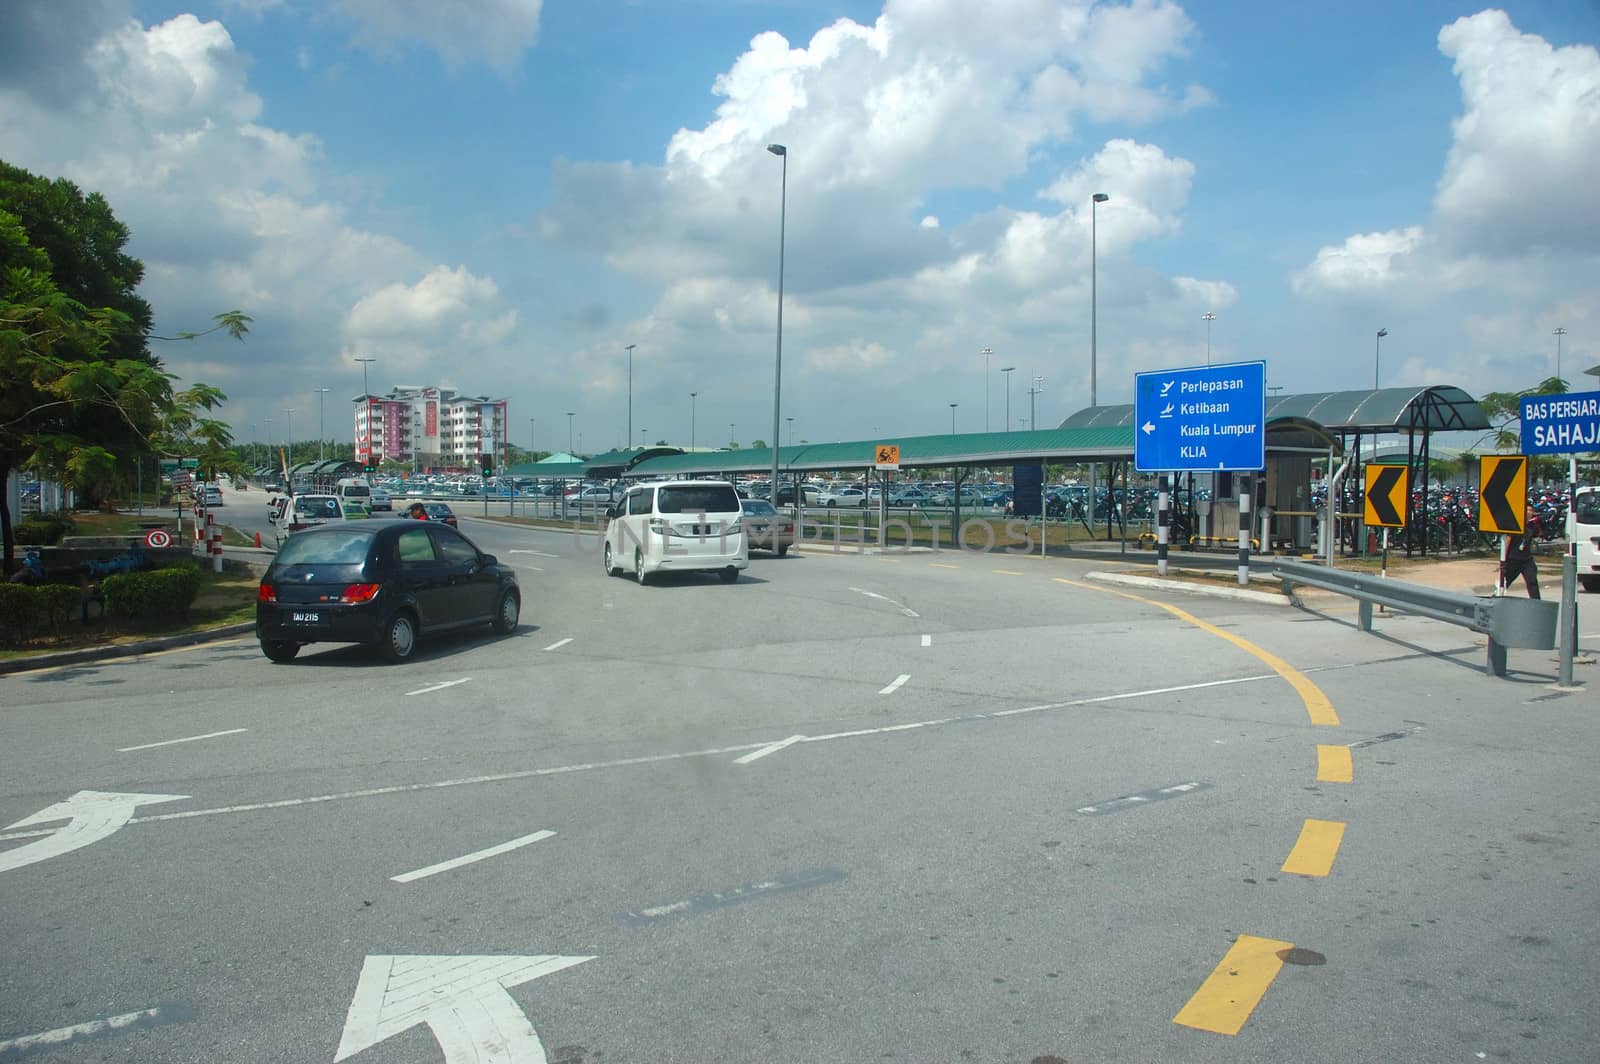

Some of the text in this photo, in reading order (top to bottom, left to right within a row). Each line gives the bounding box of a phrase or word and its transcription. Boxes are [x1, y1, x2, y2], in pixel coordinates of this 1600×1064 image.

[1181, 379, 1244, 393] Perlepasan
[1180, 402, 1230, 415] Ketibaan
[1526, 399, 1600, 420] BAS PERSIAR
[1180, 423, 1256, 437] Kuala Lumpur
[1180, 446, 1207, 458] KLIA
